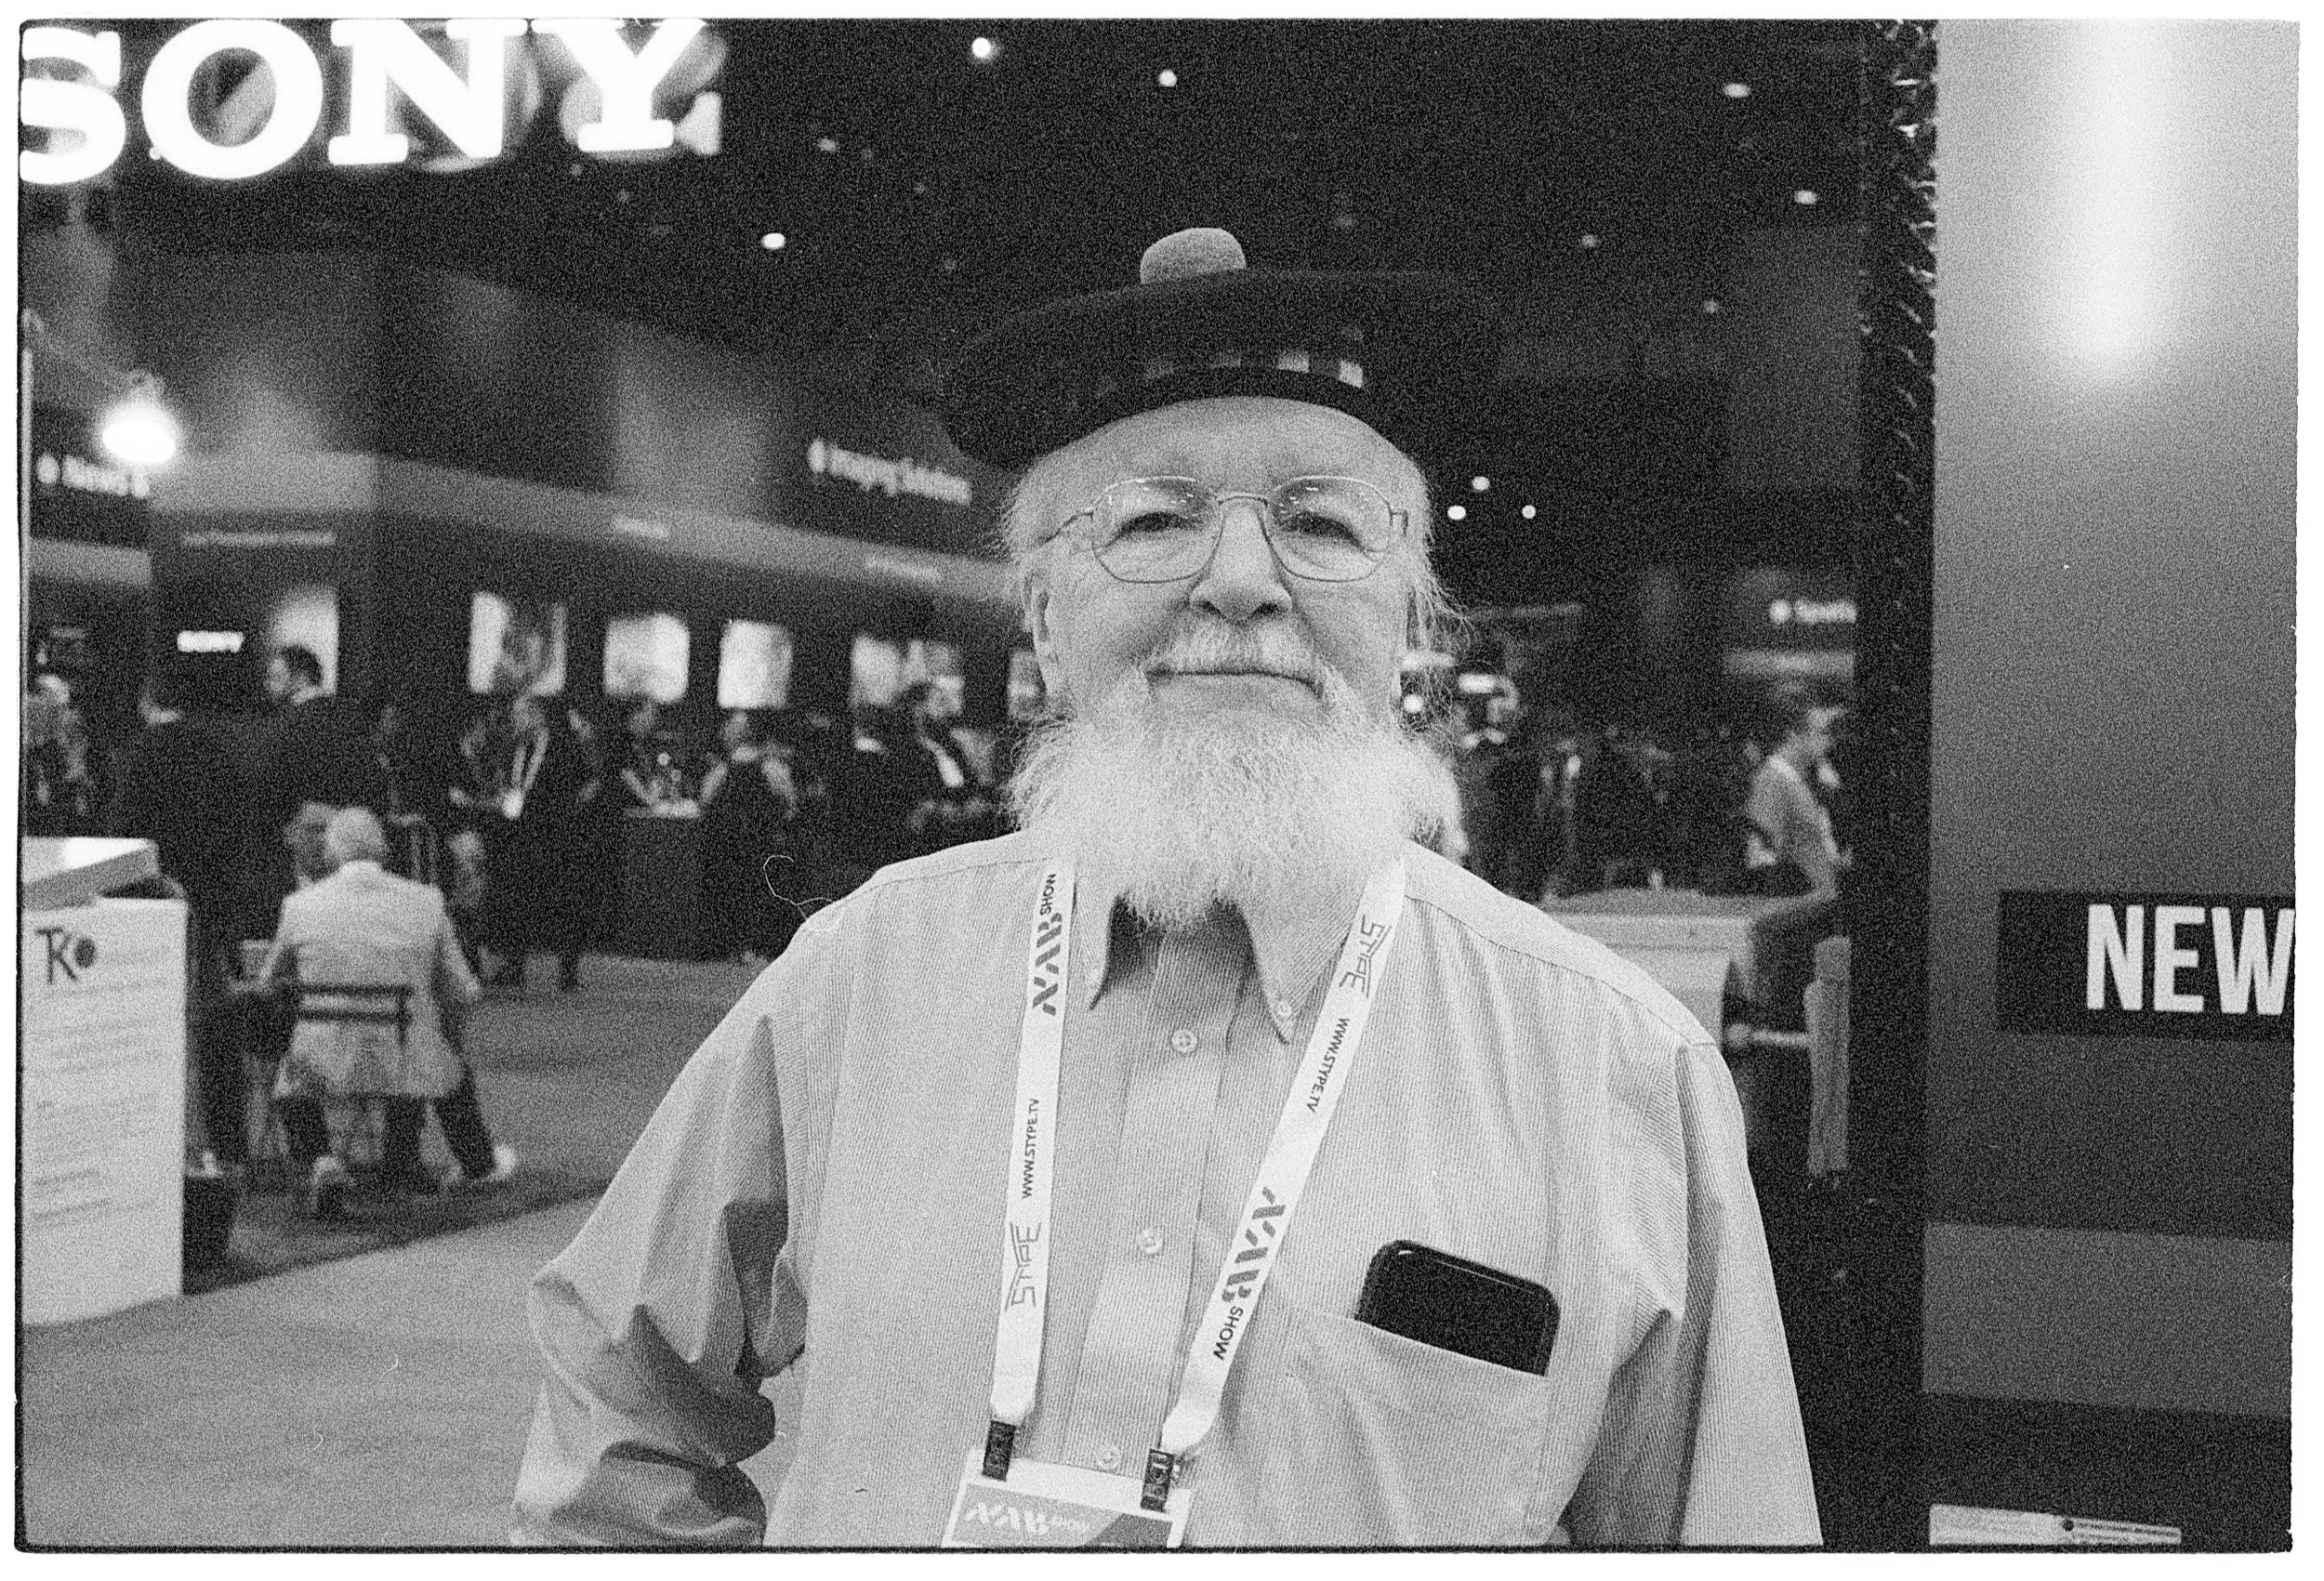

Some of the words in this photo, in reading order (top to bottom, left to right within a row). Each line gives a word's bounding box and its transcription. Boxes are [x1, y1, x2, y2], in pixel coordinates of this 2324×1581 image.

[20, 19, 707, 185] SONY
[1039, 873, 1056, 916] SHOW
[2086, 904, 2296, 1016] NEW
[1306, 1018, 1351, 1113] WWW.STYPE.TV
[1022, 1098, 1039, 1199] WWW.STYPE.TV
[1213, 1305, 1244, 1362] SHOW
